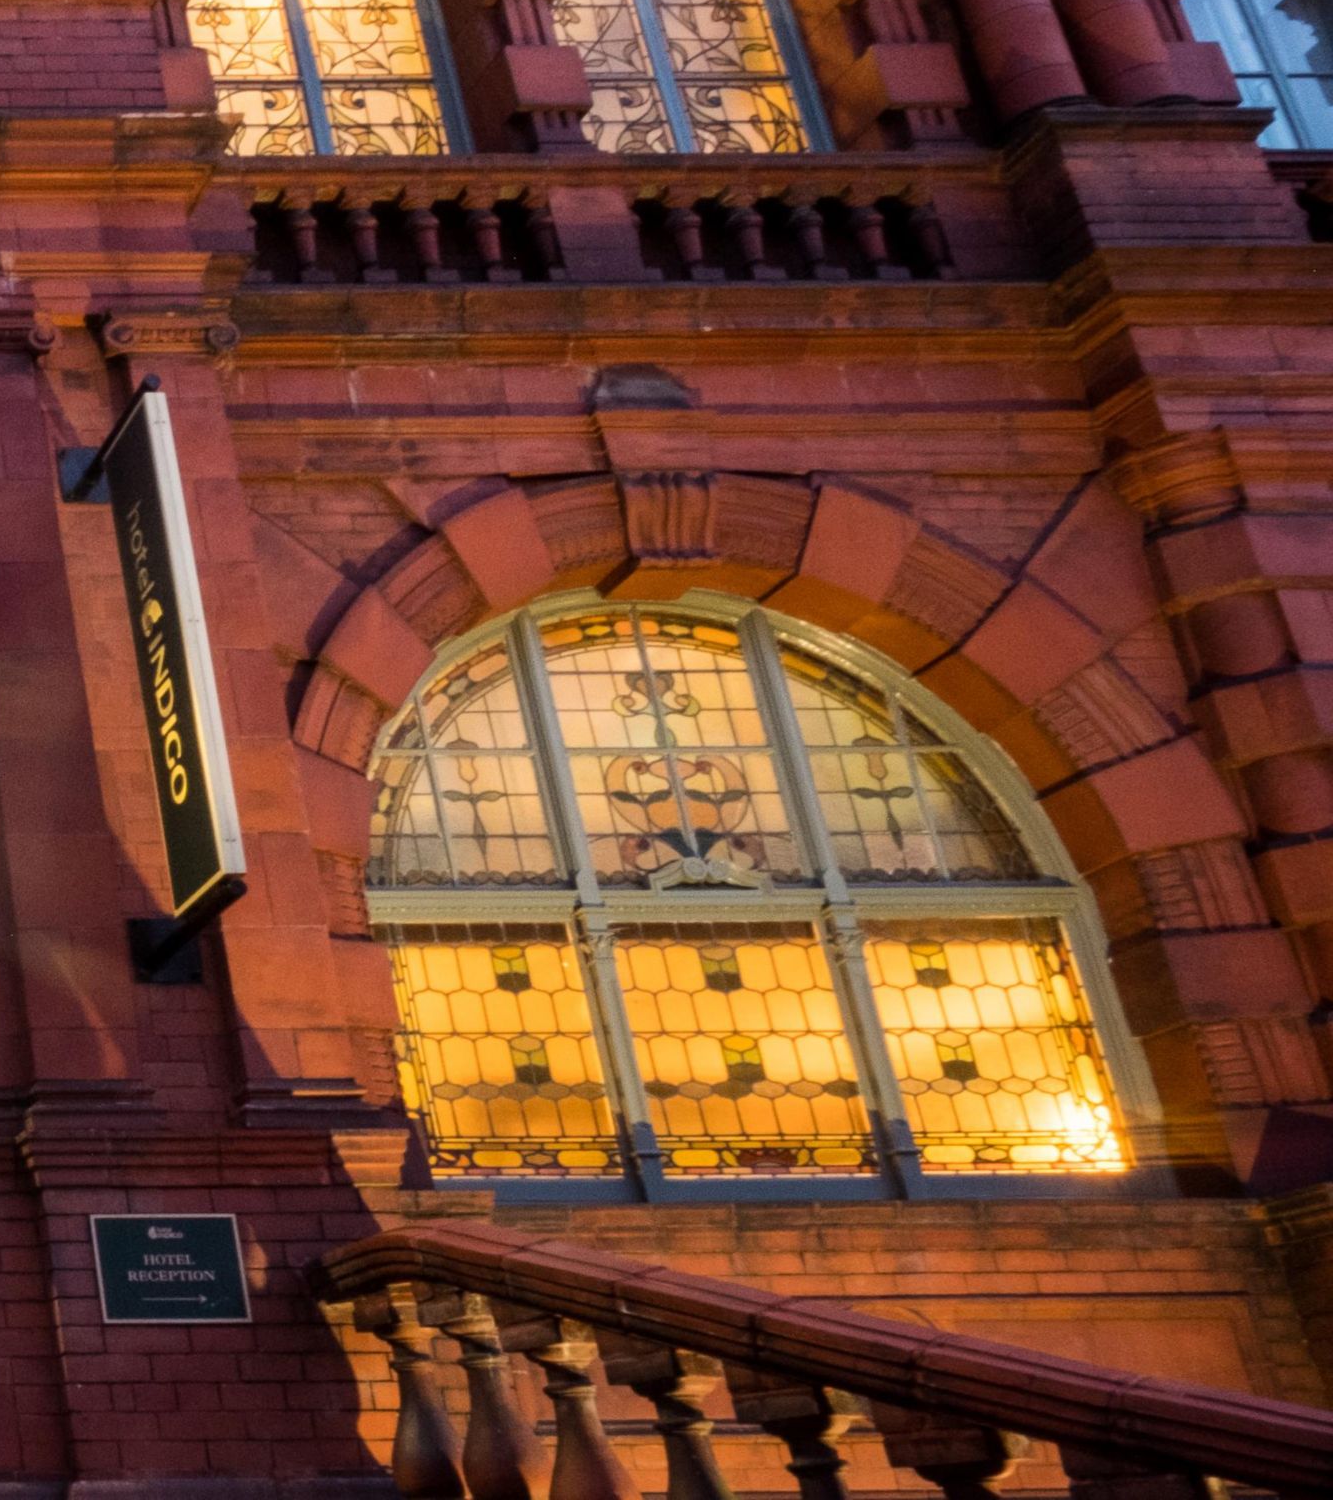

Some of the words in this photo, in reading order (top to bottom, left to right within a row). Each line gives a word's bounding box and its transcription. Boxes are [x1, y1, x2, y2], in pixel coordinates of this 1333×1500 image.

[127, 501, 155, 601] hotel
[148, 631, 189, 805] INDIGO
[143, 1254, 195, 1266] HOTEL
[127, 1270, 216, 1282] RECEPTION
